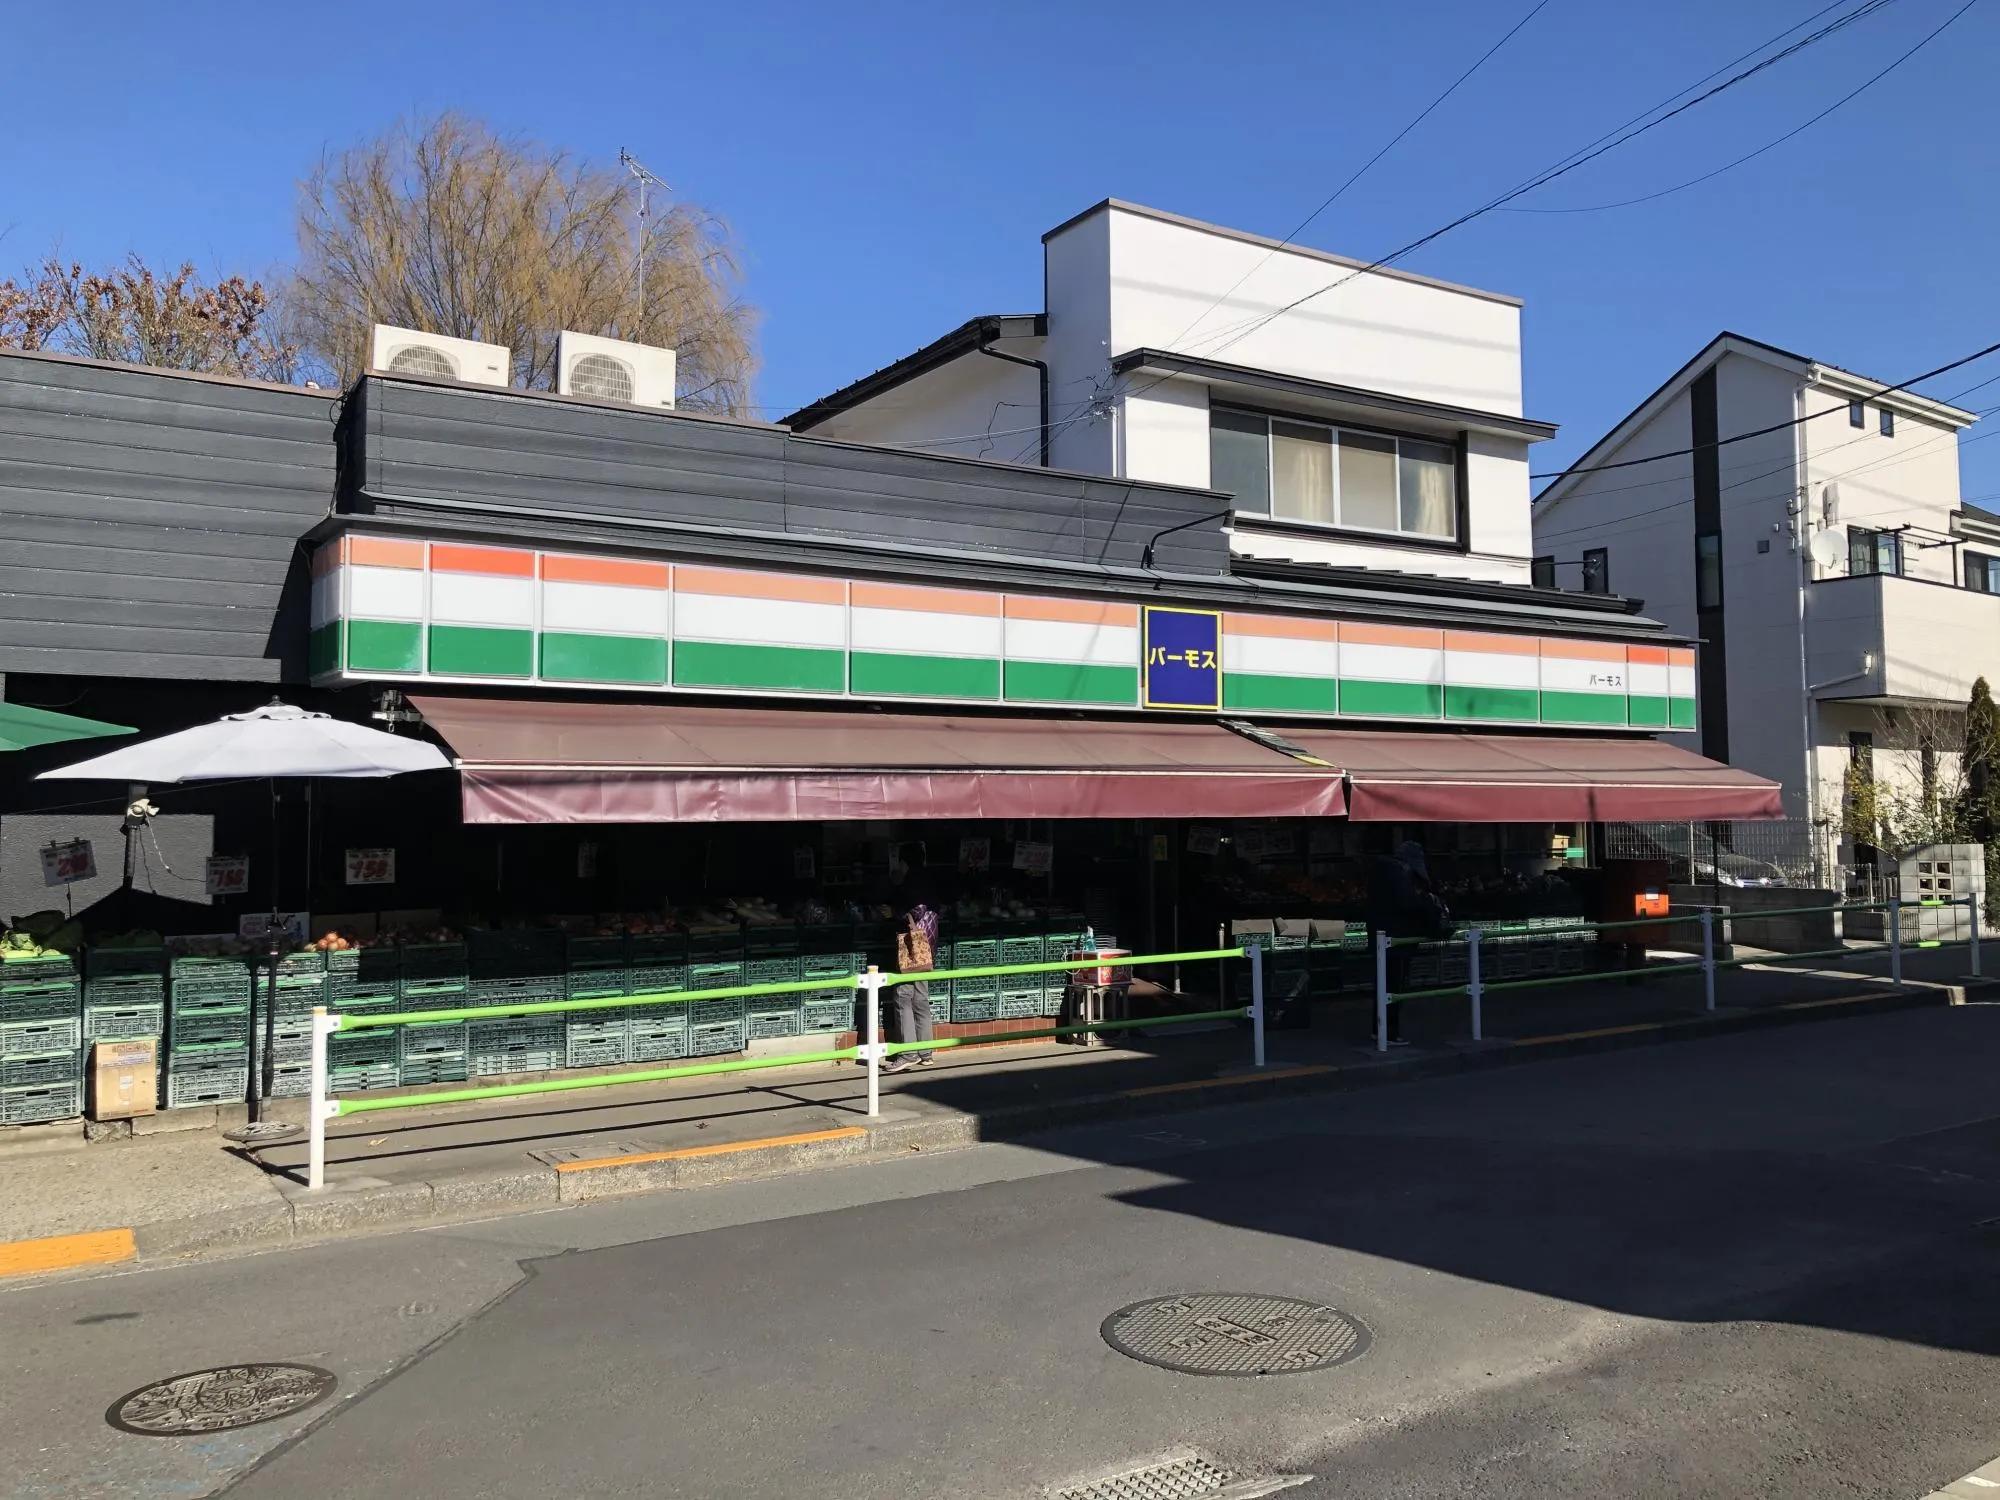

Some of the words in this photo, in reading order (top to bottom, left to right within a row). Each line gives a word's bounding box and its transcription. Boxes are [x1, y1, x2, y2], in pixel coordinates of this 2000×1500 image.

[1149, 646, 1216, 669] バーモス
[1589, 674, 1622, 687] バーモス
